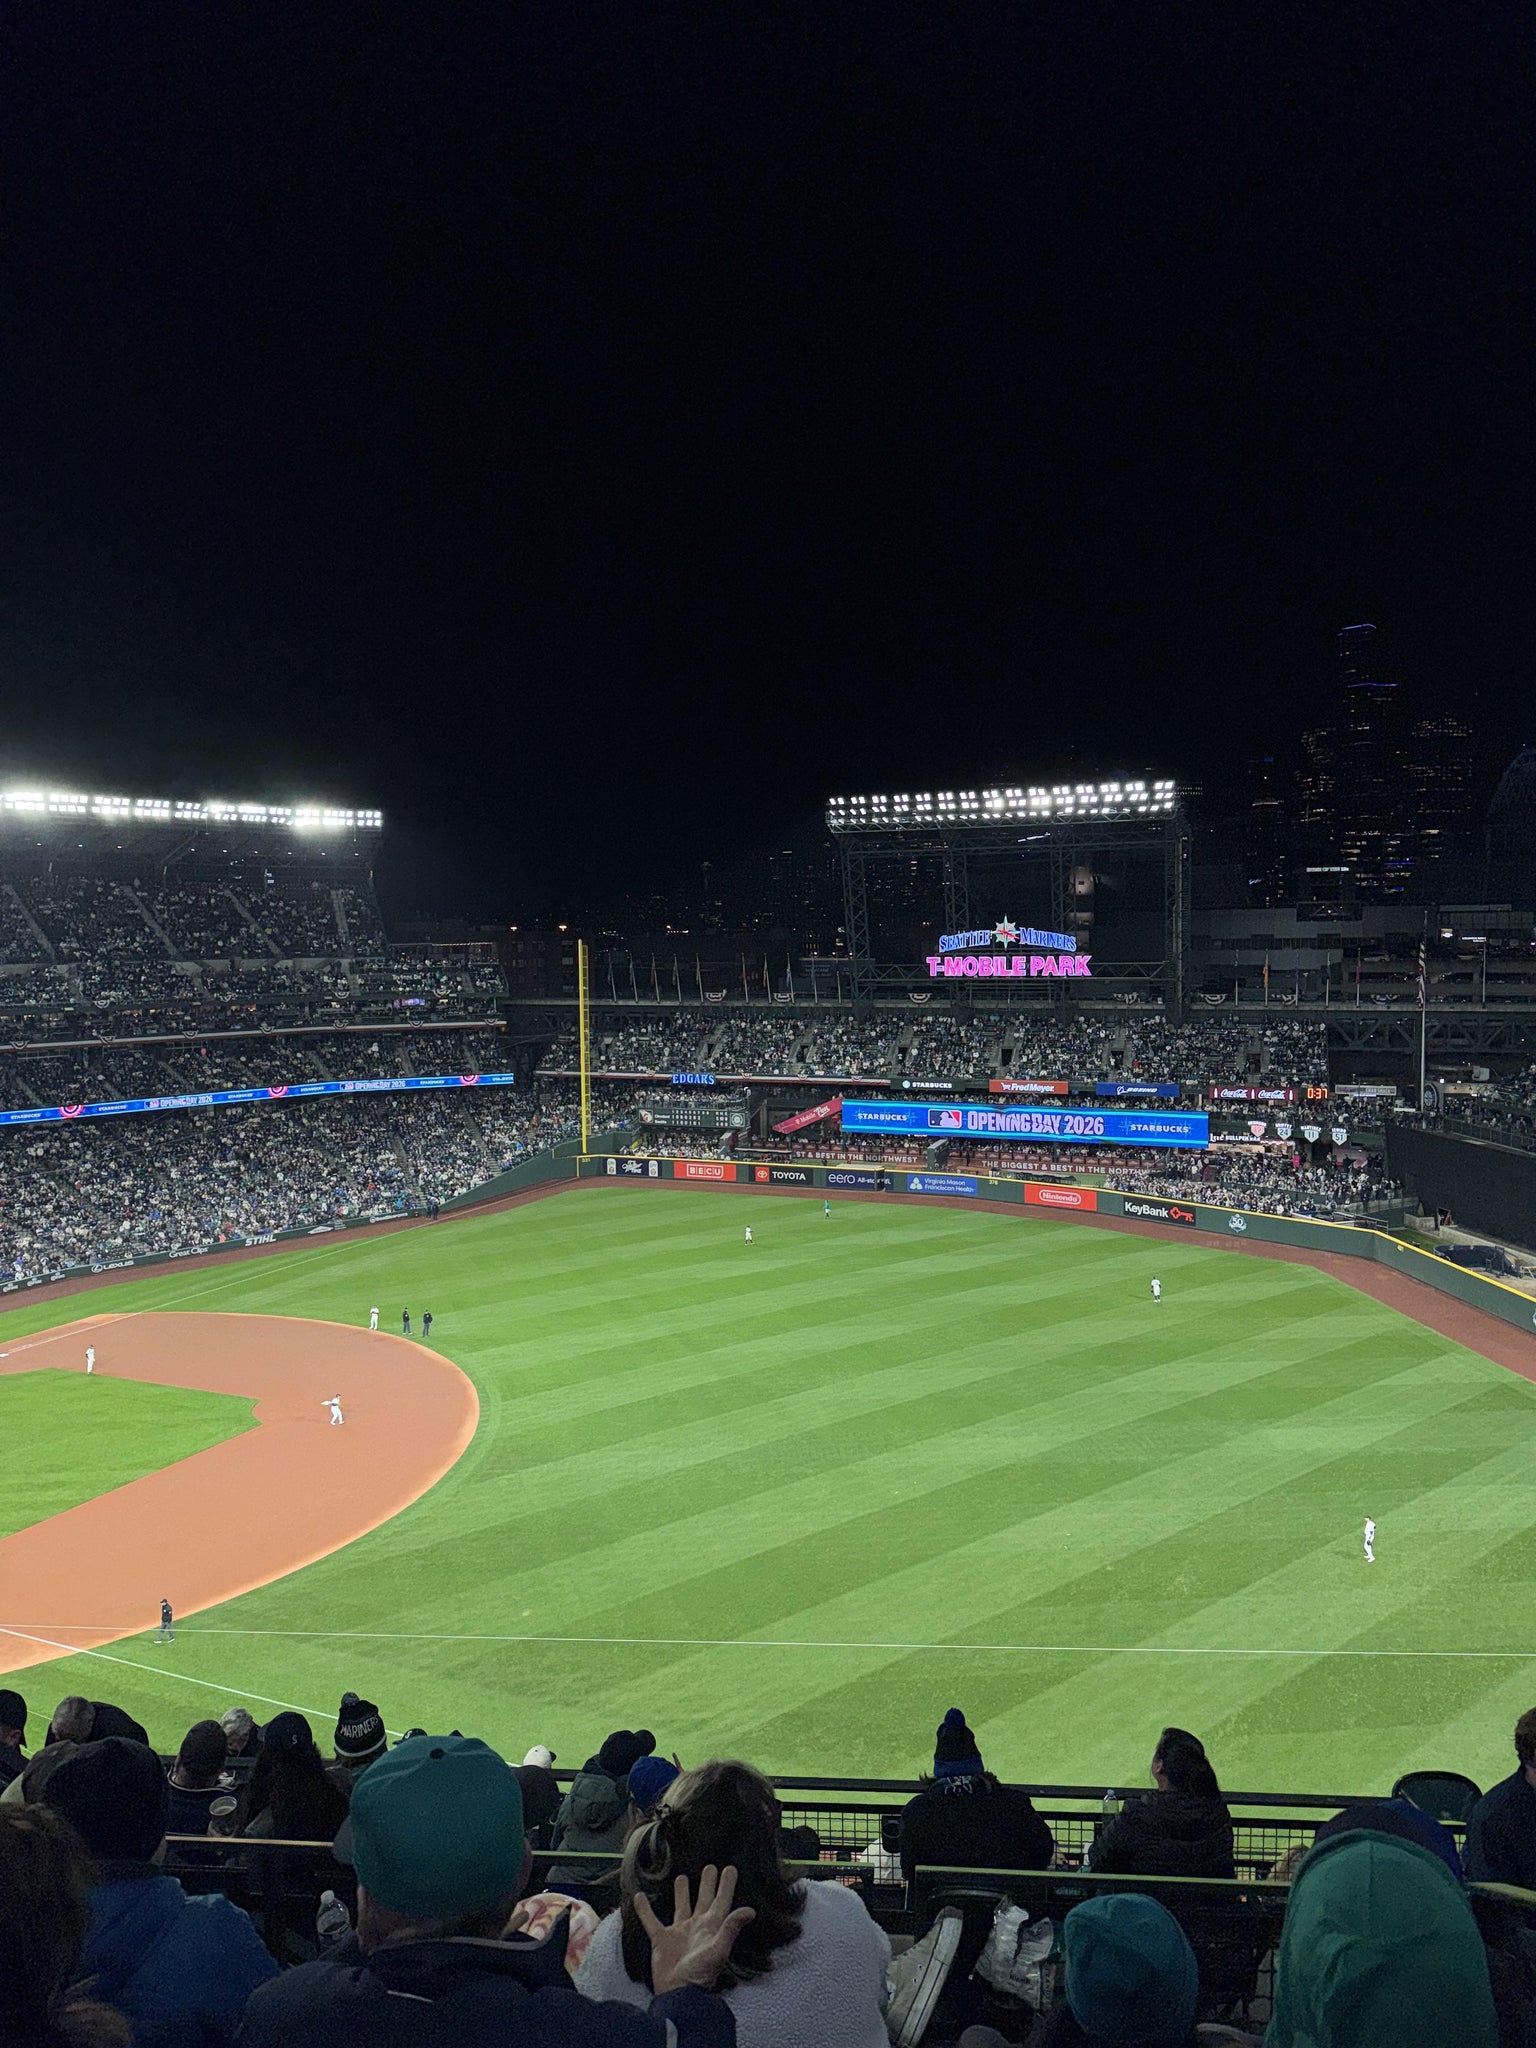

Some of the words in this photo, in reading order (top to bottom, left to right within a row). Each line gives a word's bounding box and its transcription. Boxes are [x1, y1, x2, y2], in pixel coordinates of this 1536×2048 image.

[926, 956, 1026, 977] T-MOBILE
[1030, 955, 1092, 976] PARK
[1307, 1087, 1328, 1099] 0:37
[858, 1113, 908, 1121] STARBUCKS
[968, 1111, 1032, 1133] OPENING
[1031, 1113, 1062, 1135] DAY
[1064, 1115, 1105, 1135] 2026
[1130, 1124, 1189, 1133] STARBUCKS
[1280, 1128, 1289, 1136] 24
[1308, 1131, 1315, 1139] 11
[1335, 1133, 1344, 1141] 51
[689, 1167, 721, 1175] BECU
[1001, 1162, 1038, 1170] BIGGEST
[1050, 1164, 1073, 1172] BEST
[1088, 1166, 1105, 1174] THE
[772, 1170, 806, 1181] TOYOTA
[828, 1173, 856, 1184] eero
[1043, 1192, 1078, 1202] Nintendo
[1124, 1201, 1168, 1219] KeyBank
[245, 1234, 277, 1247] STIHL
[169, 1249, 191, 1259] Great
[191, 1246, 208, 1257] Clips
[102, 1259, 134, 1270] LEXUS
[340, 1715, 380, 1739] MARINERS
[292, 1734, 298, 1745] S
